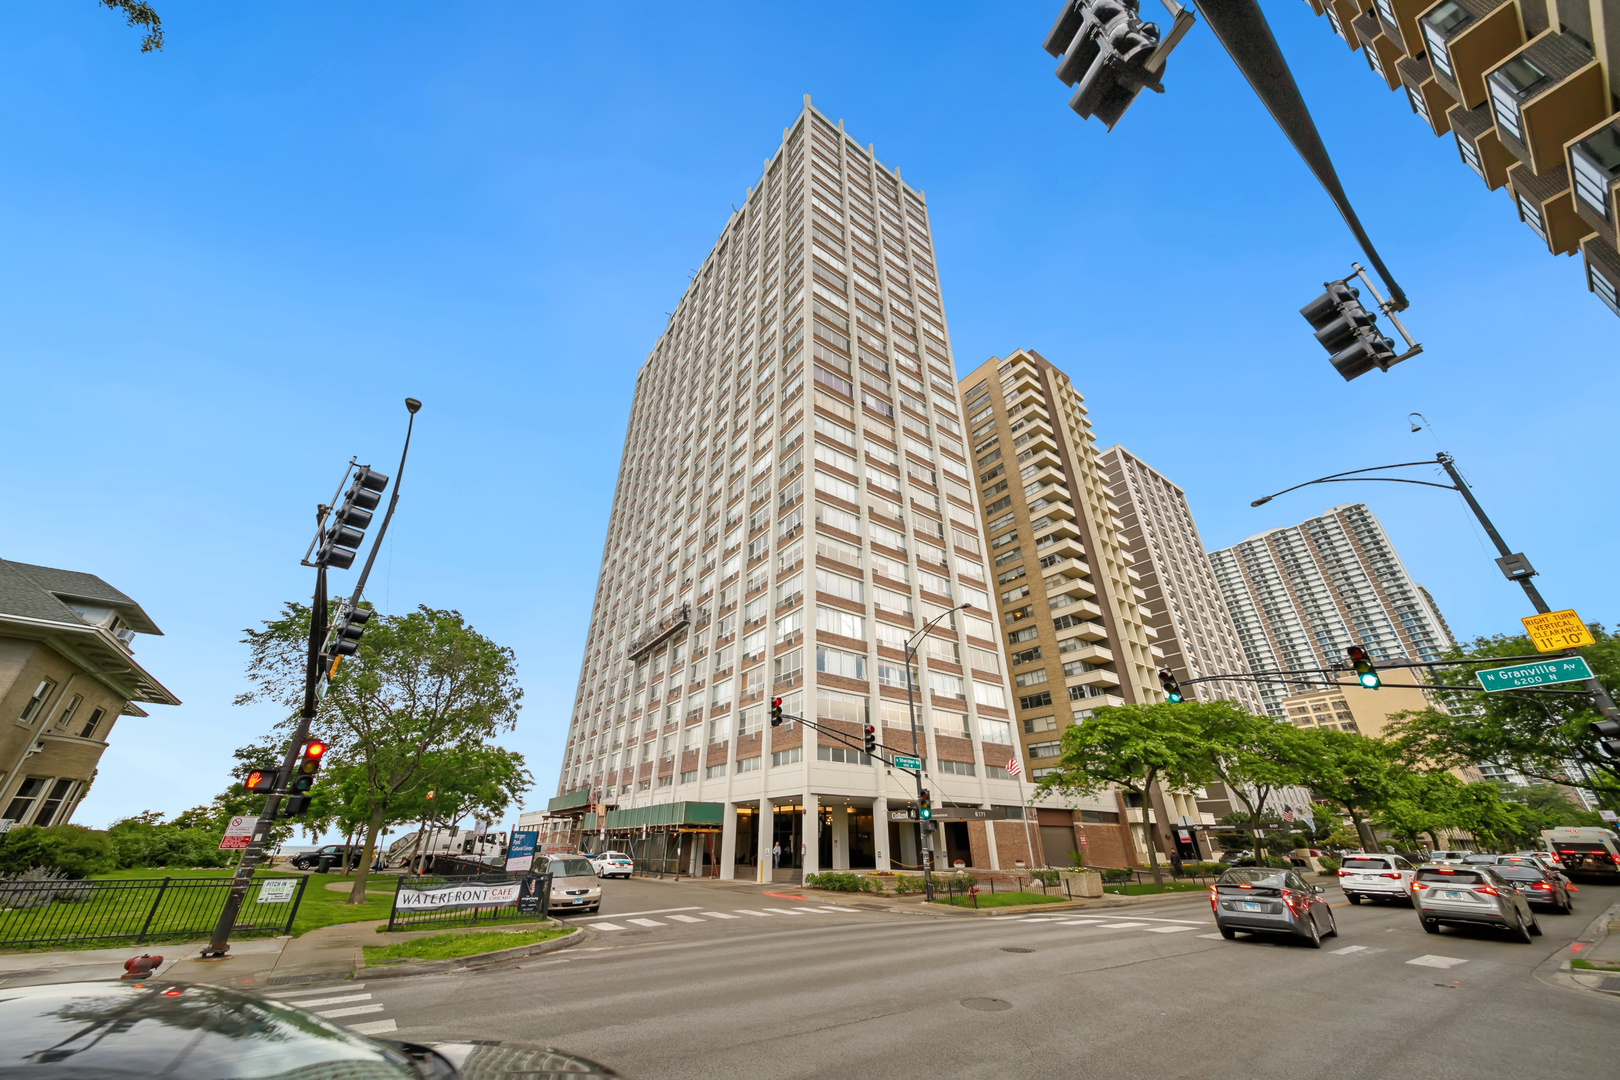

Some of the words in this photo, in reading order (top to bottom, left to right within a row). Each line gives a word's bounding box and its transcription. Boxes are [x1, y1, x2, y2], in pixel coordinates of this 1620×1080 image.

[1525, 617, 1549, 627] RIGHT
[1553, 611, 1575, 621] TURN
[1534, 620, 1574, 632] VERTICAL
[1533, 625, 1583, 639] CLEARANCE
[1540, 632, 1583, 649] 11'-10"
[1499, 665, 1557, 680] Granville
[1563, 663, 1575, 671] Av
[1514, 676, 1542, 686] 6200
[402, 889, 490, 905] WATERFRONT
[491, 888, 512, 896] CAFE
